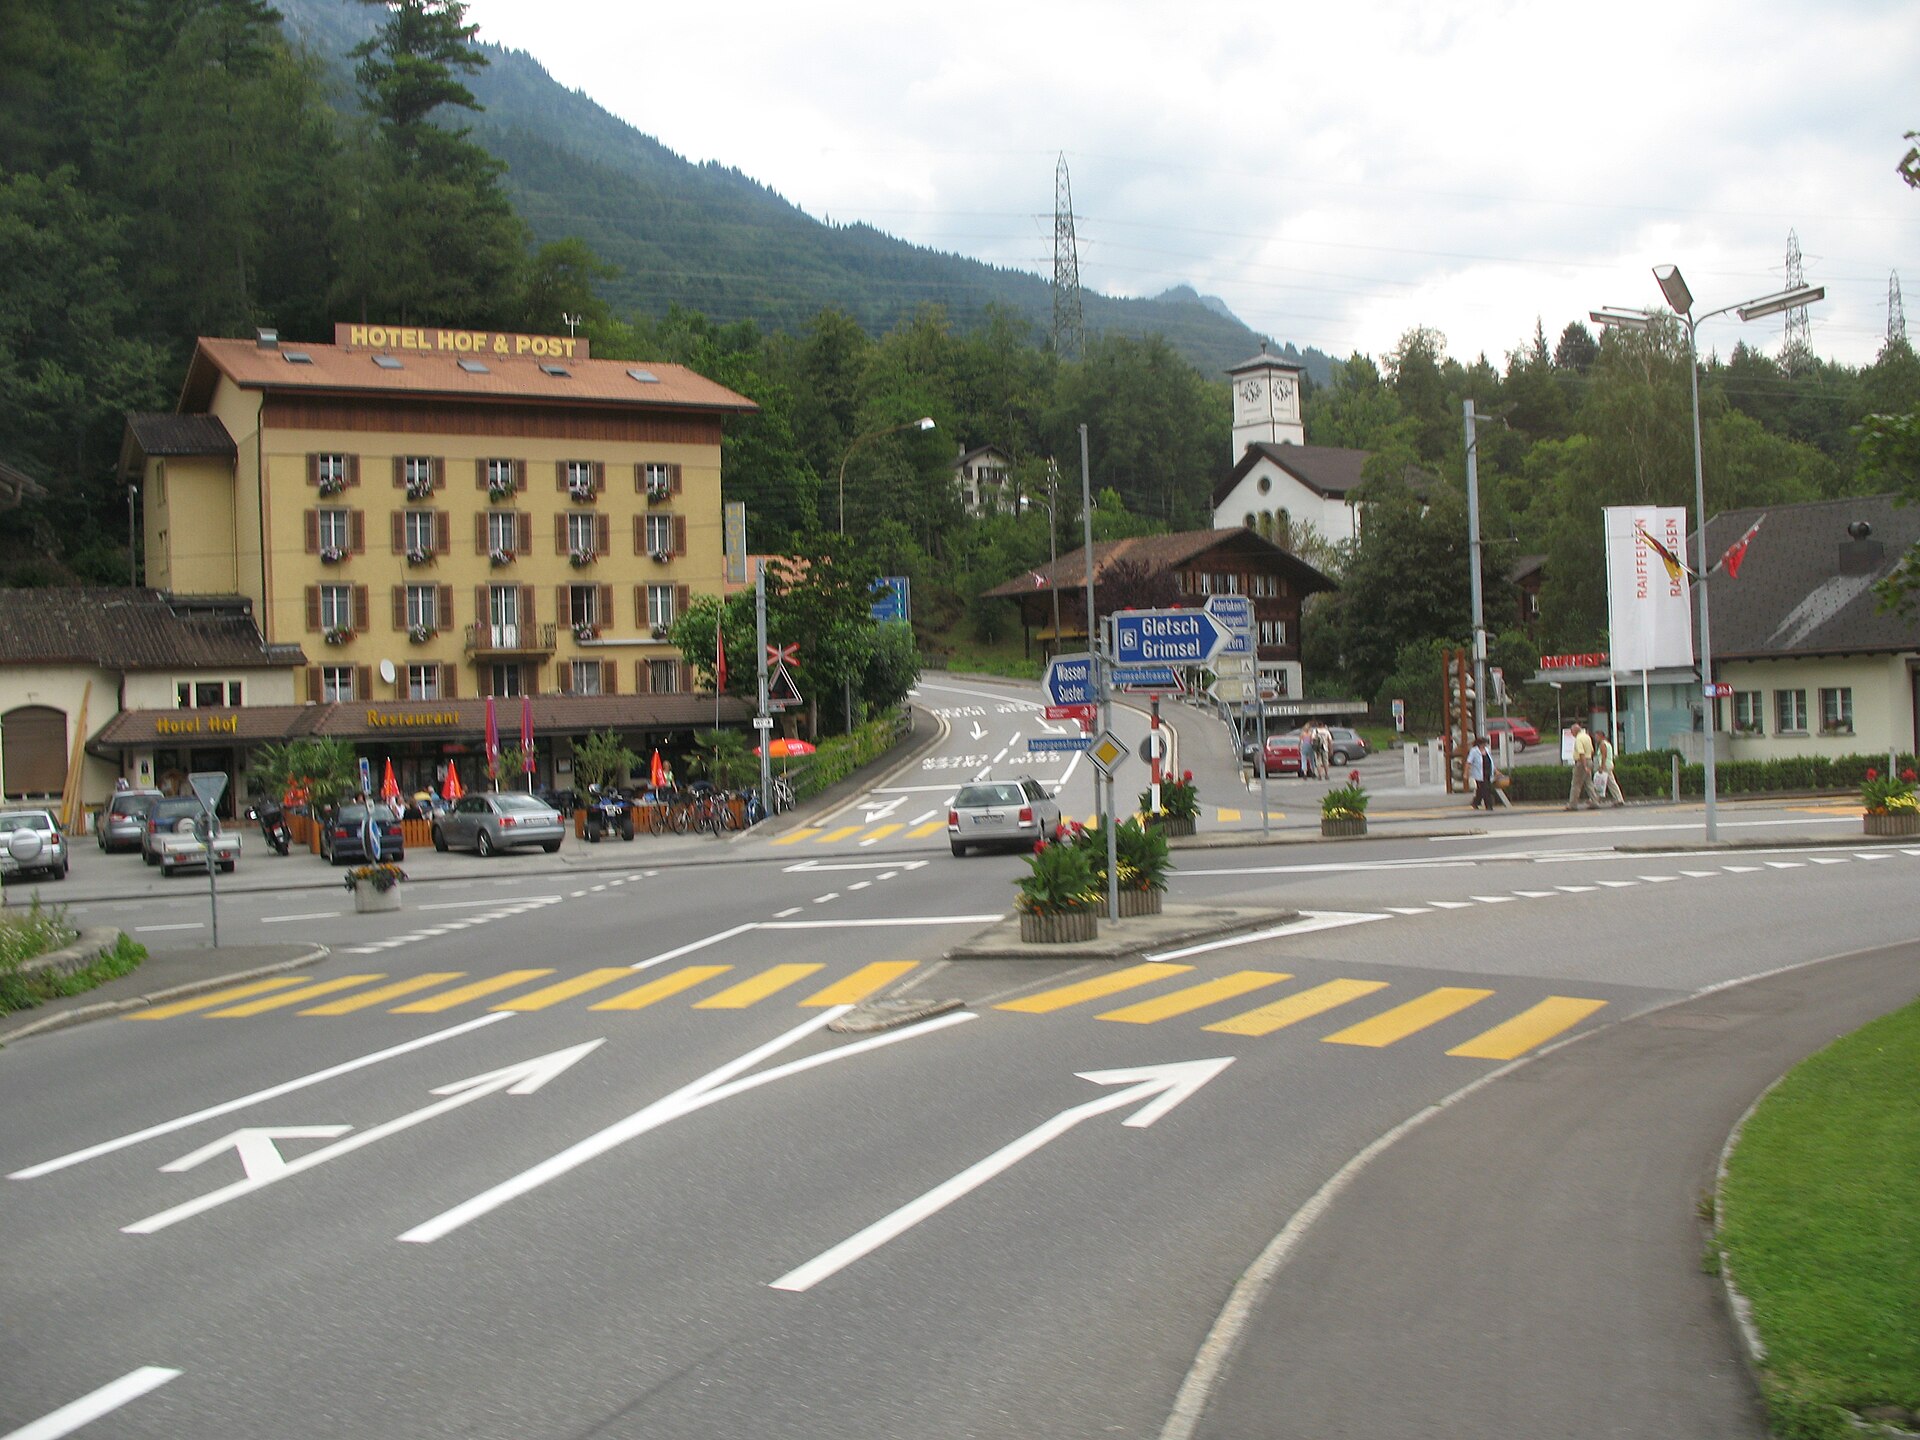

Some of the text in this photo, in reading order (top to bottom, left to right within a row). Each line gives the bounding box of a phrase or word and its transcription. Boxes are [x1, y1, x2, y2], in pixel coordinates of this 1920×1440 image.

[351, 326, 576, 357] HOTEL HOF & POST
[728, 506, 742, 579] HOTEL
[1635, 519, 1647, 599] RAIFFEISEN
[1666, 519, 1682, 597] RAISEN
[1142, 616, 1200, 637] Gletsch
[1123, 632, 1134, 648] 6
[1142, 638, 1201, 659] Grimsel
[1056, 663, 1087, 682] Wassen
[156, 714, 239, 734] Hotel Hof
[366, 709, 460, 727] Restaurant
